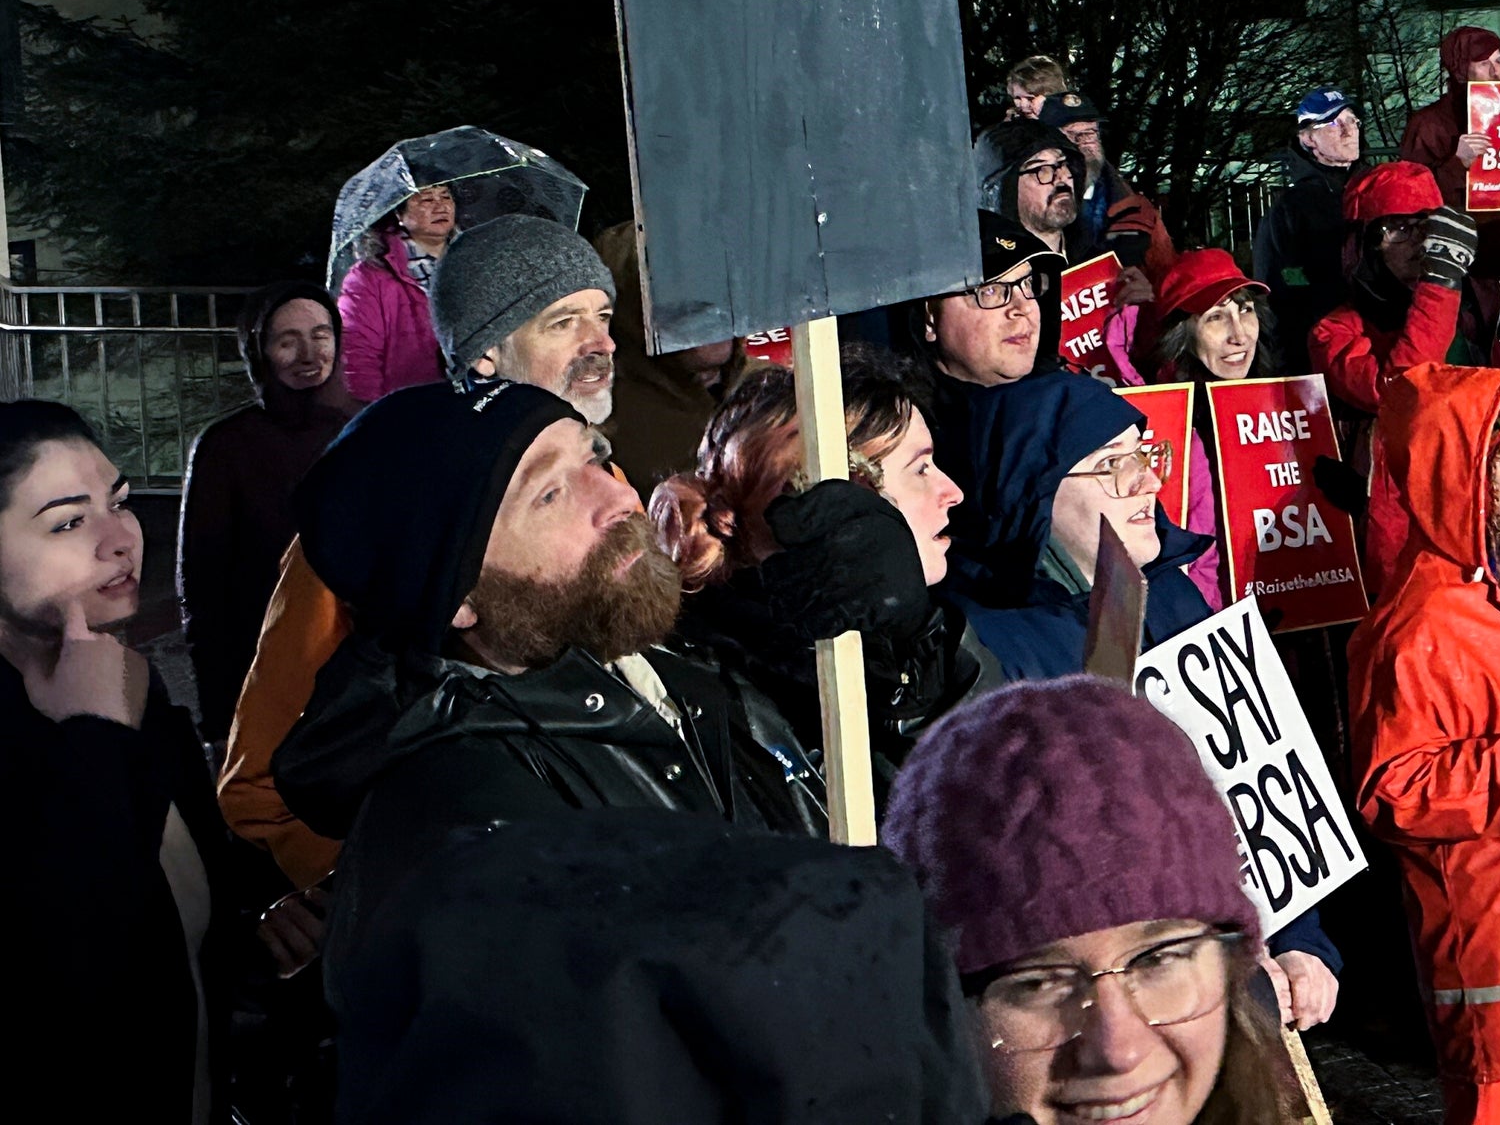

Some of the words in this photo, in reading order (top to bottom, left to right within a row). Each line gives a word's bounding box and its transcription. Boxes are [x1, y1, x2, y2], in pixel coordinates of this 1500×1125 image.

[1061, 282, 1110, 322] AISE
[1065, 328, 1103, 358] THE
[1236, 410, 1311, 446] RAISE
[1264, 461, 1302, 488] THE
[1252, 503, 1333, 553] BSA
[1244, 567, 1355, 596] #RaisetheAKBSA
[1177, 611, 1281, 770] SAY
